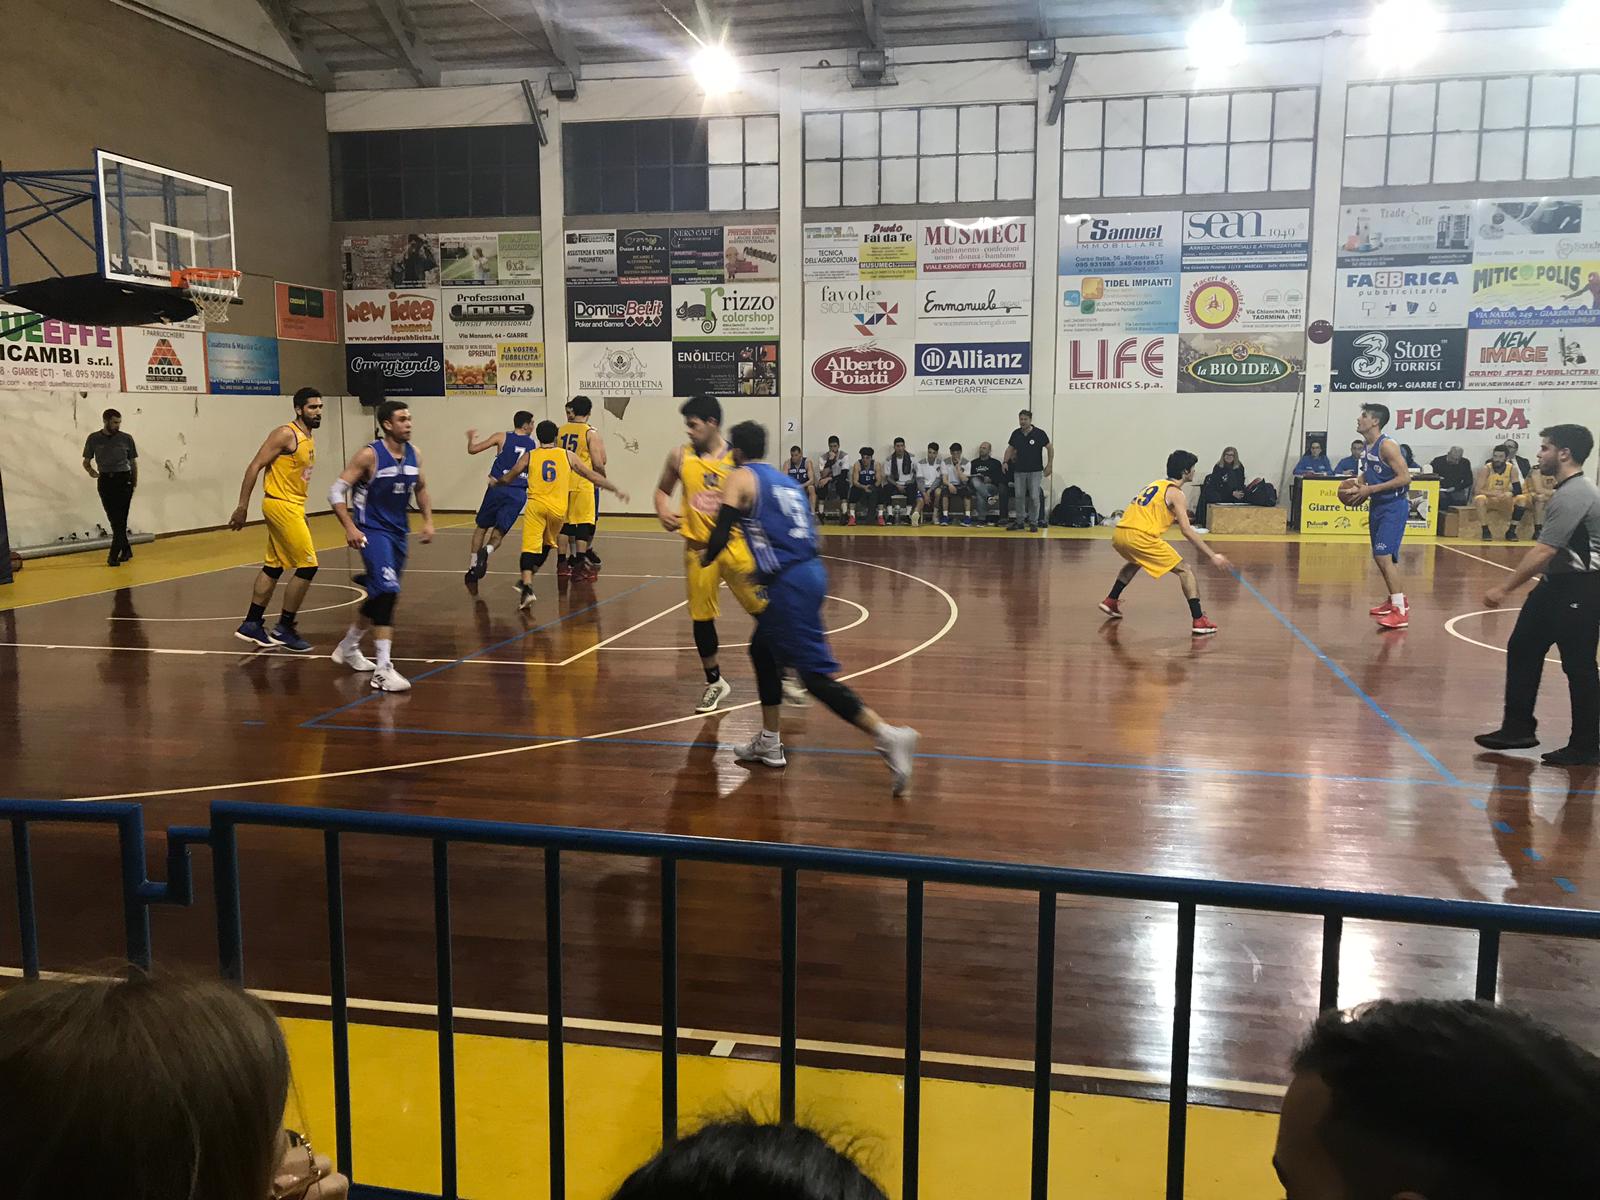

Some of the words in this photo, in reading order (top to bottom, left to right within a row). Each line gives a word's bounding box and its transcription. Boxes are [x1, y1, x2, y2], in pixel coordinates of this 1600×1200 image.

[1090, 219, 1162, 240] Samuel
[1188, 211, 1266, 239] sean
[864, 234, 880, 242] Fai
[884, 234, 896, 242] da
[900, 233, 912, 242] Te
[924, 223, 1026, 246] MUSMECI
[1270, 228, 1295, 240] 1940
[1132, 279, 1172, 287] IMPIANTI
[1347, 271, 1459, 288] FABBRICA
[457, 293, 525, 302] Professional
[822, 284, 876, 302] favole
[1359, 288, 1447, 296] pubblicitaria
[722, 290, 774, 311] rizzo
[820, 302, 877, 314] SICILIANE
[722, 312, 774, 324] colorshop
[347, 334, 440, 342] www.newideapubblicita.it
[1494, 331, 1536, 348] NEW
[1394, 340, 1441, 359] Store
[1480, 346, 1548, 363] IMAGE
[87, 356, 113, 366] s.r.l.
[824, 356, 895, 371] Alberto
[946, 350, 1022, 368] Allianz
[1070, 337, 1164, 380] LIFE
[12, 367, 38, 377] GIARRE
[41, 368, 54, 378] (CT)
[62, 369, 73, 378] Tel.
[76, 370, 89, 378] 095
[148, 367, 183, 375] ANGELO
[1197, 366, 1206, 376] la
[1210, 363, 1238, 375] BIO
[1241, 363, 1280, 375] IDEA
[1394, 362, 1441, 372] TORRISI
[510, 370, 533, 381] 6X3
[830, 370, 889, 384] Poiatti
[1069, 381, 1132, 390] ELECTRONICS
[1134, 381, 1163, 390] S.p.a.
[1349, 382, 1385, 390] Callipoli,
[1314, 399, 1320, 408] 2
[1395, 407, 1530, 430] FICHERA
[788, 422, 794, 432] 2
[561, 433, 579, 453] 15
[515, 446, 526, 462] 7
[542, 460, 557, 482] 6
[1308, 503, 1341, 512] Giarre
[1344, 502, 1370, 512] Città
